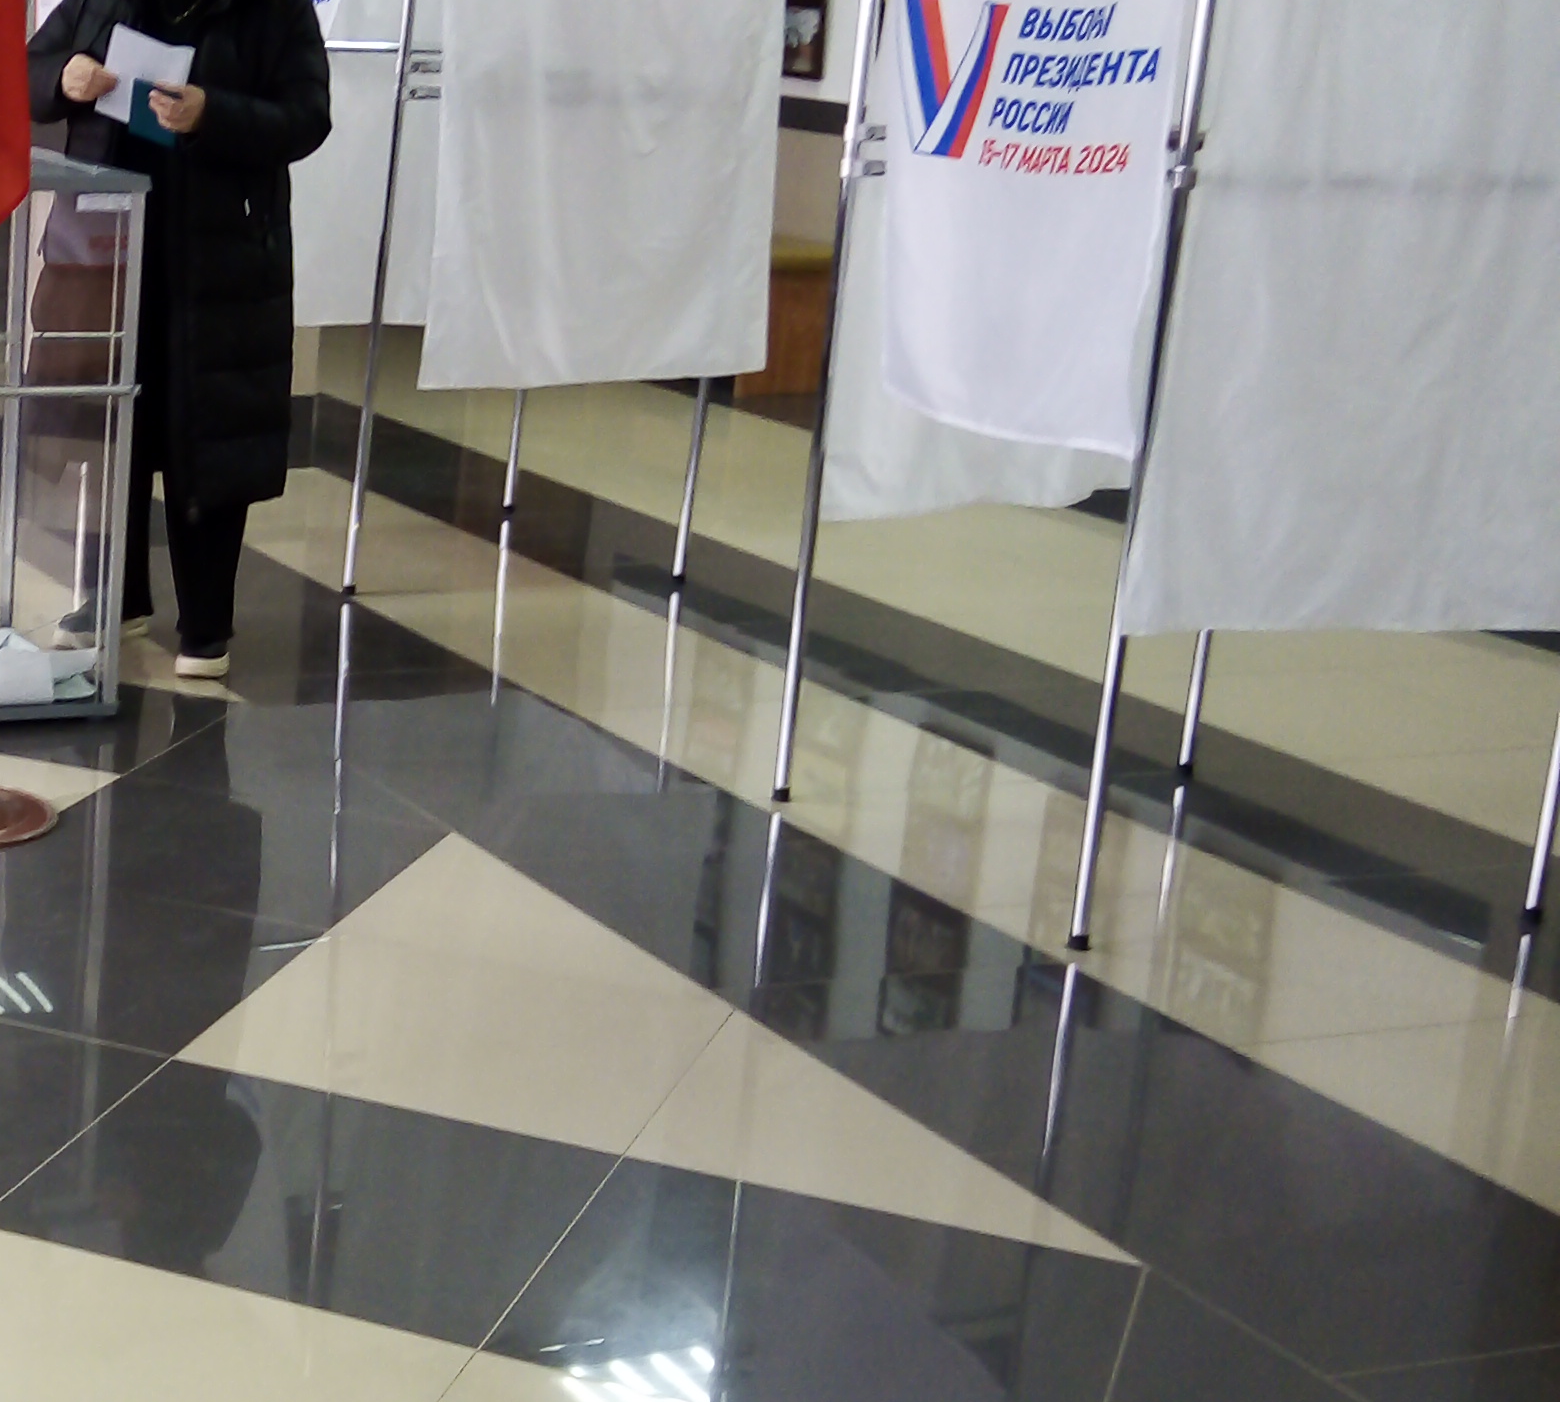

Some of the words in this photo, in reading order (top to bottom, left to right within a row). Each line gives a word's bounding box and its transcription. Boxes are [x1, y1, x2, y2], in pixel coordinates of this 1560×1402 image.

[1001, 46, 1162, 94] ПРЕЗИДЕНТА
[988, 96, 1075, 135] РОССИИ
[1015, 144, 1072, 174] МАРТА
[1073, 142, 1131, 174] 2024
